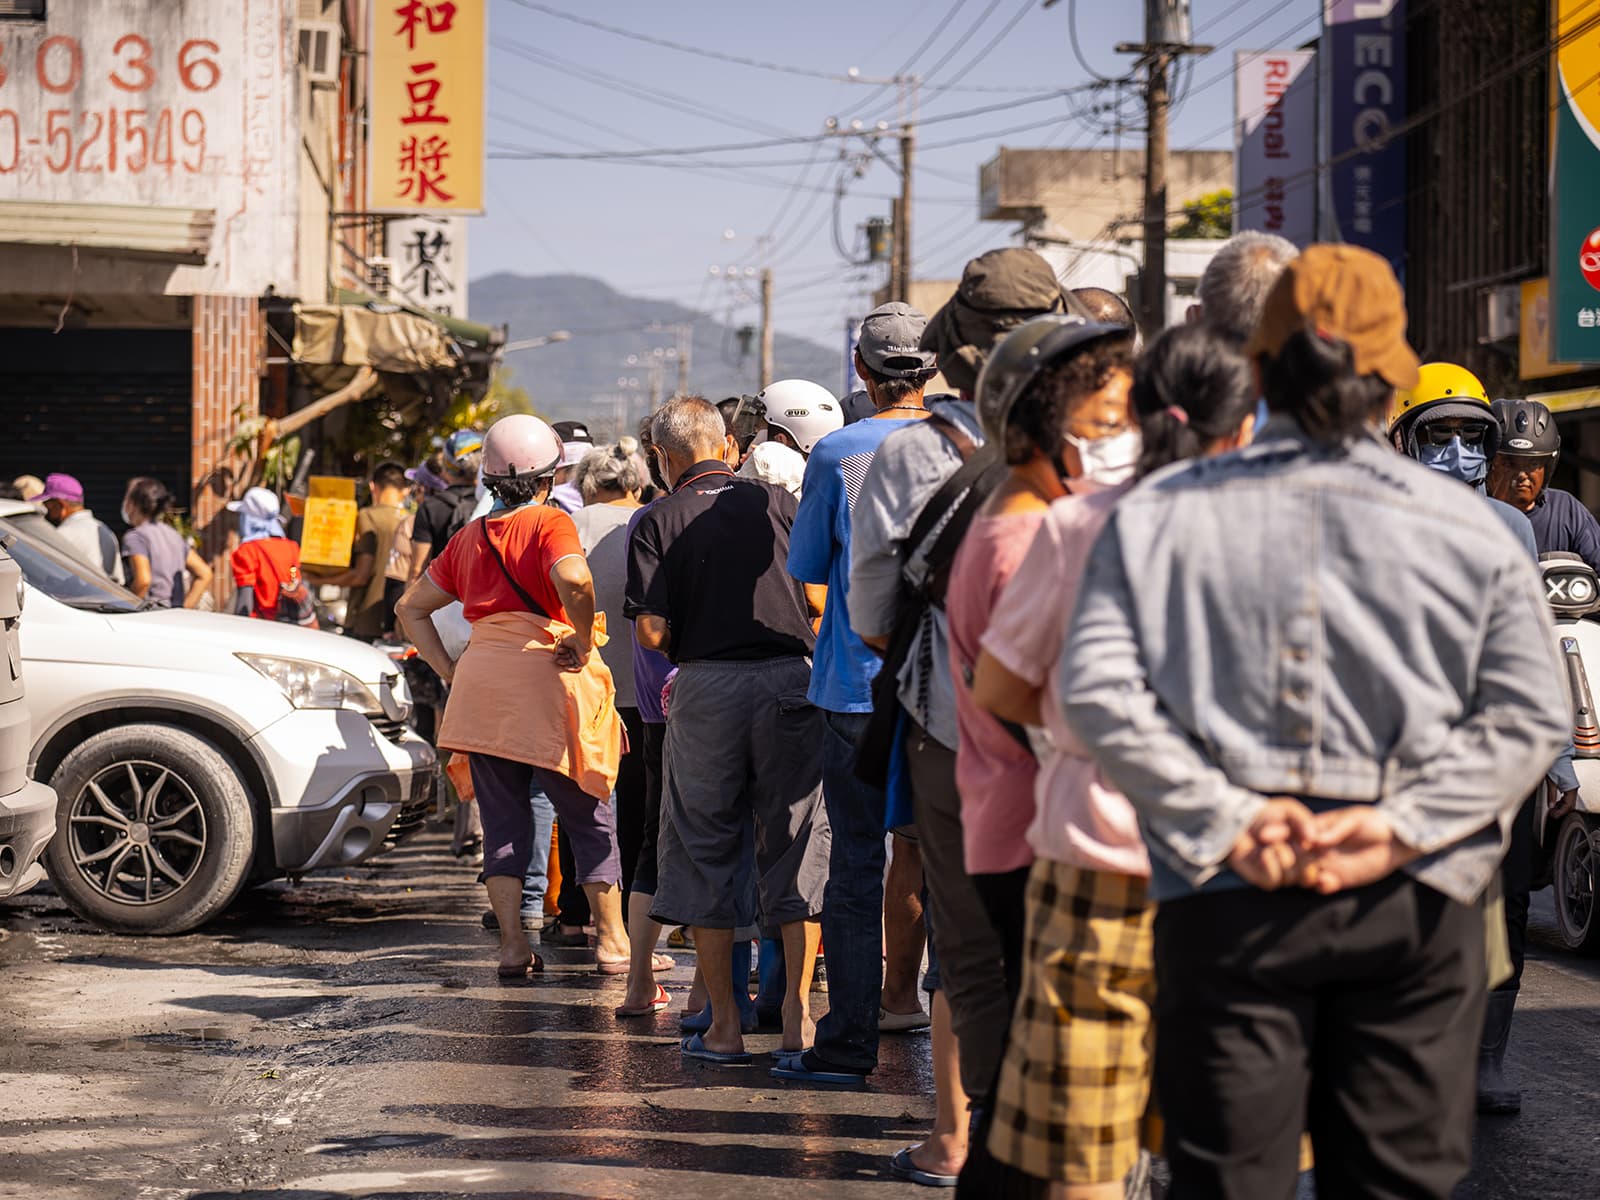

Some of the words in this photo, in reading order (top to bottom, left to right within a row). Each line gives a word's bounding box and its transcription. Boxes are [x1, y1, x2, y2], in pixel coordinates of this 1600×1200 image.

[0, 33, 221, 94] 036
[394, 0, 457, 203] 和豆漿
[1264, 59, 1291, 159] Rinnai
[1577, 307, 1600, 327] 台
